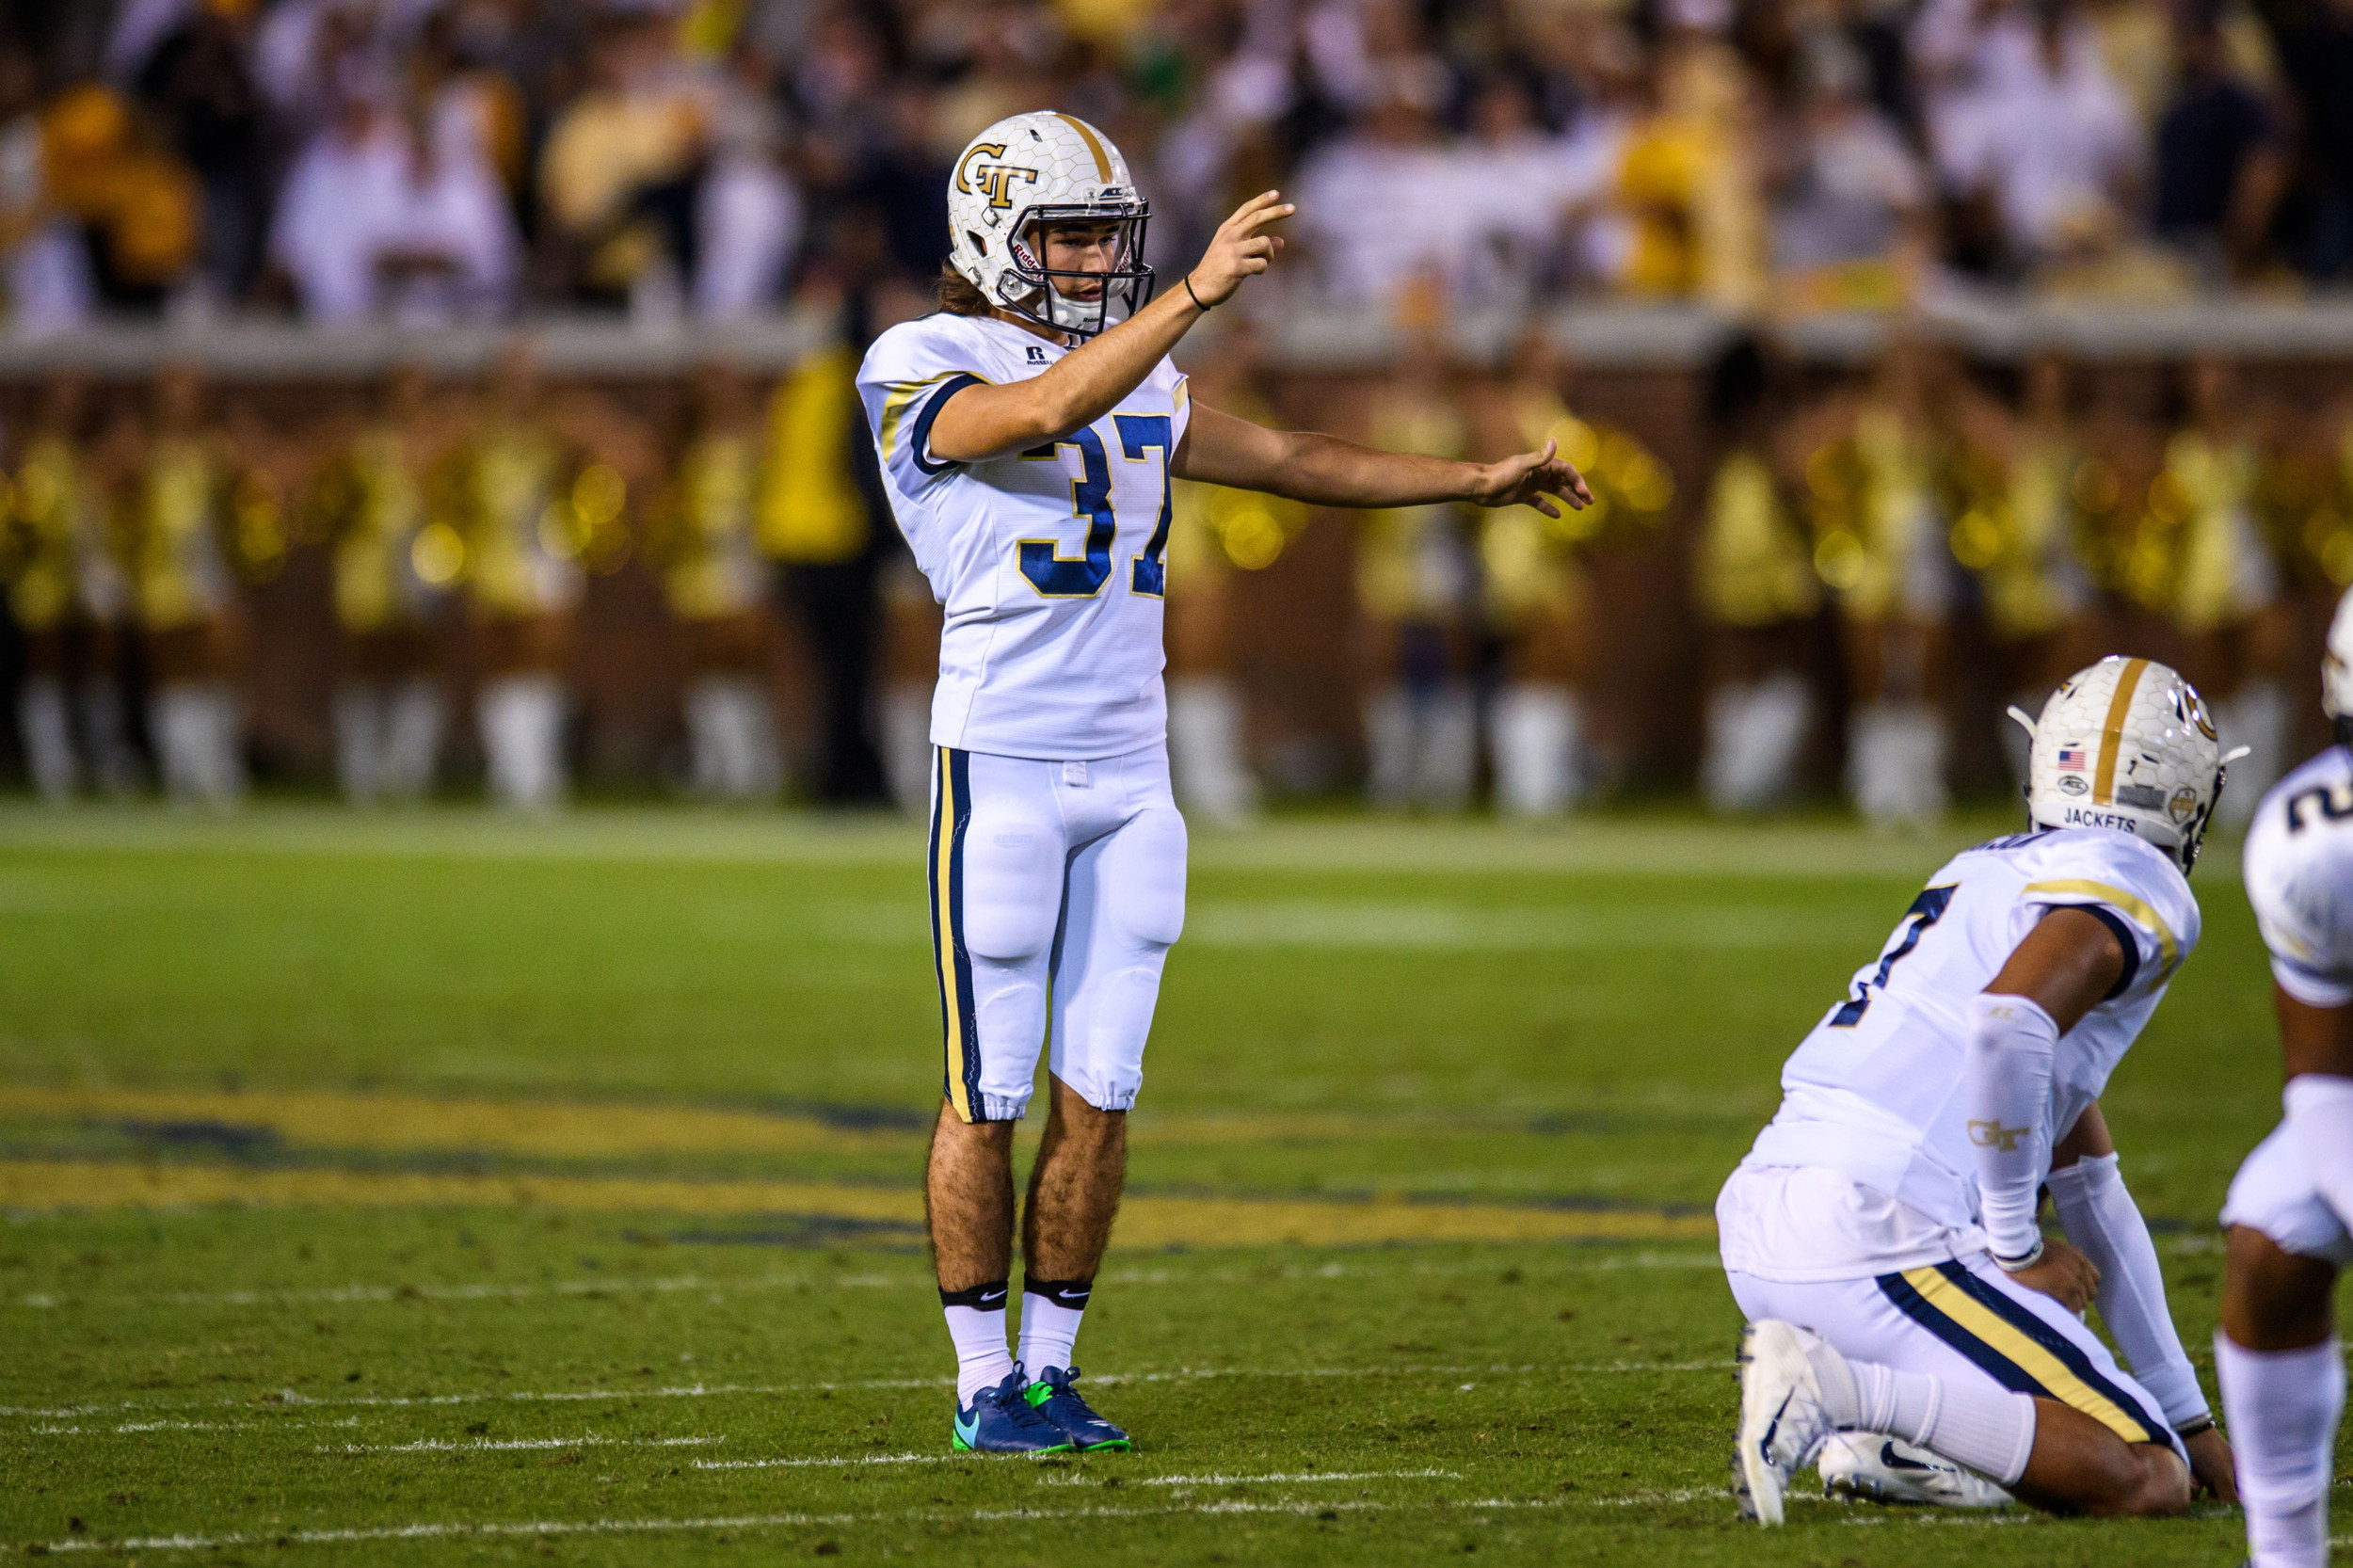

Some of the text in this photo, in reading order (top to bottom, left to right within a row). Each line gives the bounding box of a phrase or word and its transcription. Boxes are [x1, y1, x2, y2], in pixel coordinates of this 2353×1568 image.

[956, 143, 1038, 209] GT
[1026, 346, 1046, 360] R
[1016, 411, 1173, 599] 37
[2064, 808, 2137, 834] JACKETS
[1828, 882, 1961, 1031] 7
[1966, 1120, 2030, 1153] GT
